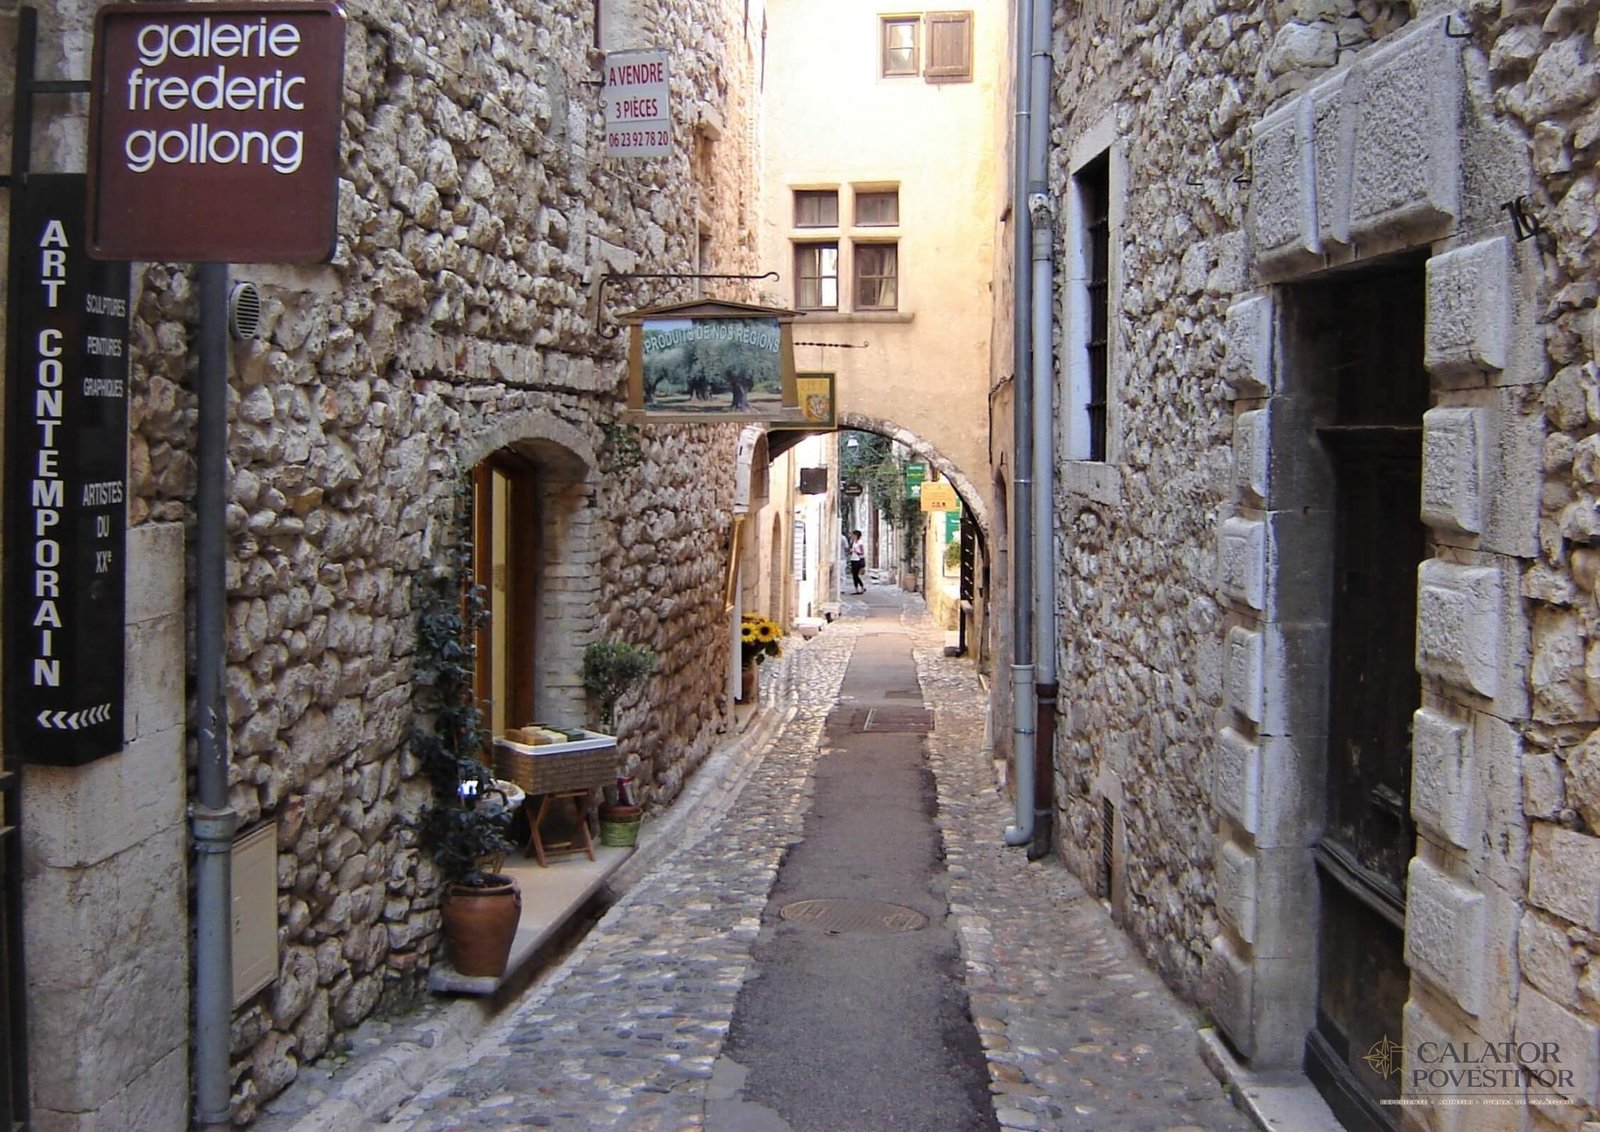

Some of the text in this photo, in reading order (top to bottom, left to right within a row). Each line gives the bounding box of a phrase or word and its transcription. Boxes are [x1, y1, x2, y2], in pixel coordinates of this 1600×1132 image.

[137, 17, 301, 67] galerie
[127, 65, 306, 110] frederic
[608, 62, 664, 87] A VENDRE
[615, 96, 658, 119] 3 PIÈCES
[125, 122, 305, 174] gollong
[1500, 194, 1538, 243] 16
[86, 294, 126, 317] SCULPTURES
[87, 336, 122, 358] PEINTURES
[643, 325, 781, 354] PRODUITS DE NOS RÉGIONS
[83, 377, 124, 398] GRAPHIQUES
[32, 220, 69, 687] ART CONTEMPORAIN
[82, 480, 123, 506] ARTISTES
[96, 515, 110, 538] DU
